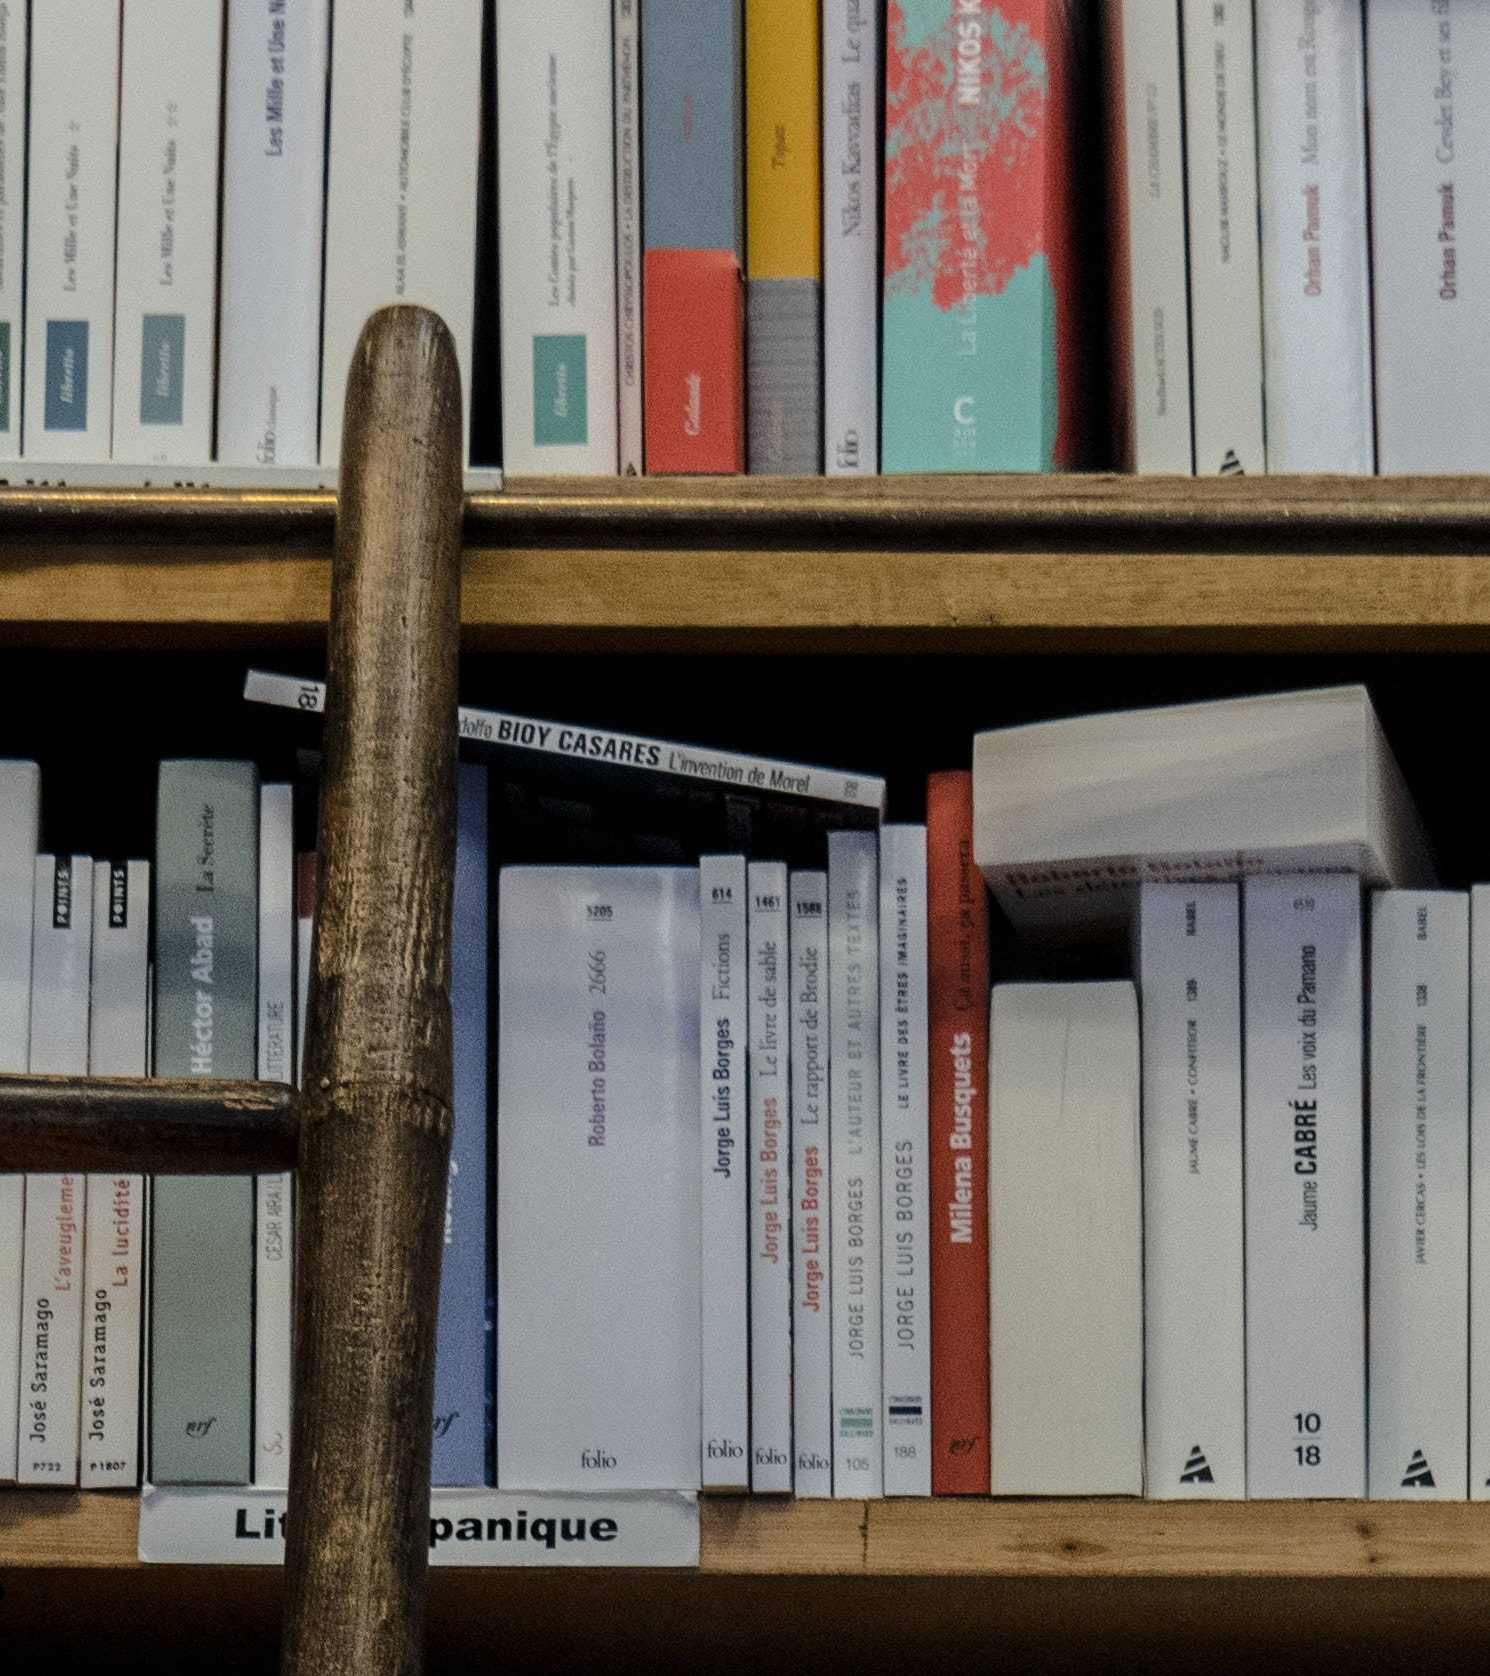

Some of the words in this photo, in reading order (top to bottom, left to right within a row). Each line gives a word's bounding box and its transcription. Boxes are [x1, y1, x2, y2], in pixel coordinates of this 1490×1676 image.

[1436, 183, 1456, 242] Pamuk
[1437, 247, 1457, 301] Orhan
[197, 804, 215, 866] Secrète
[196, 871, 214, 894] La
[192, 916, 216, 986] Abad
[587, 950, 607, 996] 2666
[711, 933, 730, 1001] Fictions
[1295, 945, 1317, 1005] Pamano
[189, 989, 214, 1074] Héctor
[586, 1009, 607, 1073] Bolaño
[1298, 1009, 1316, 1027] du
[1301, 1032, 1316, 1060] voix
[711, 1017, 735, 1082] Borges
[1298, 1064, 1317, 1090] Les
[586, 1077, 606, 1148] Roberto
[712, 1085, 731, 1123] Luis
[949, 1032, 977, 1149] Busquets
[712, 1127, 735, 1180] Jorge
[1293, 1100, 1322, 1176] CABRÉ
[110, 1179, 130, 1257] lucidité
[947, 1157, 973, 1245] Milena
[1299, 1181, 1318, 1232] Jaume
[111, 1265, 129, 1288] La
[88, 1289, 112, 1389] Saramago
[87, 1397, 105, 1442] José
